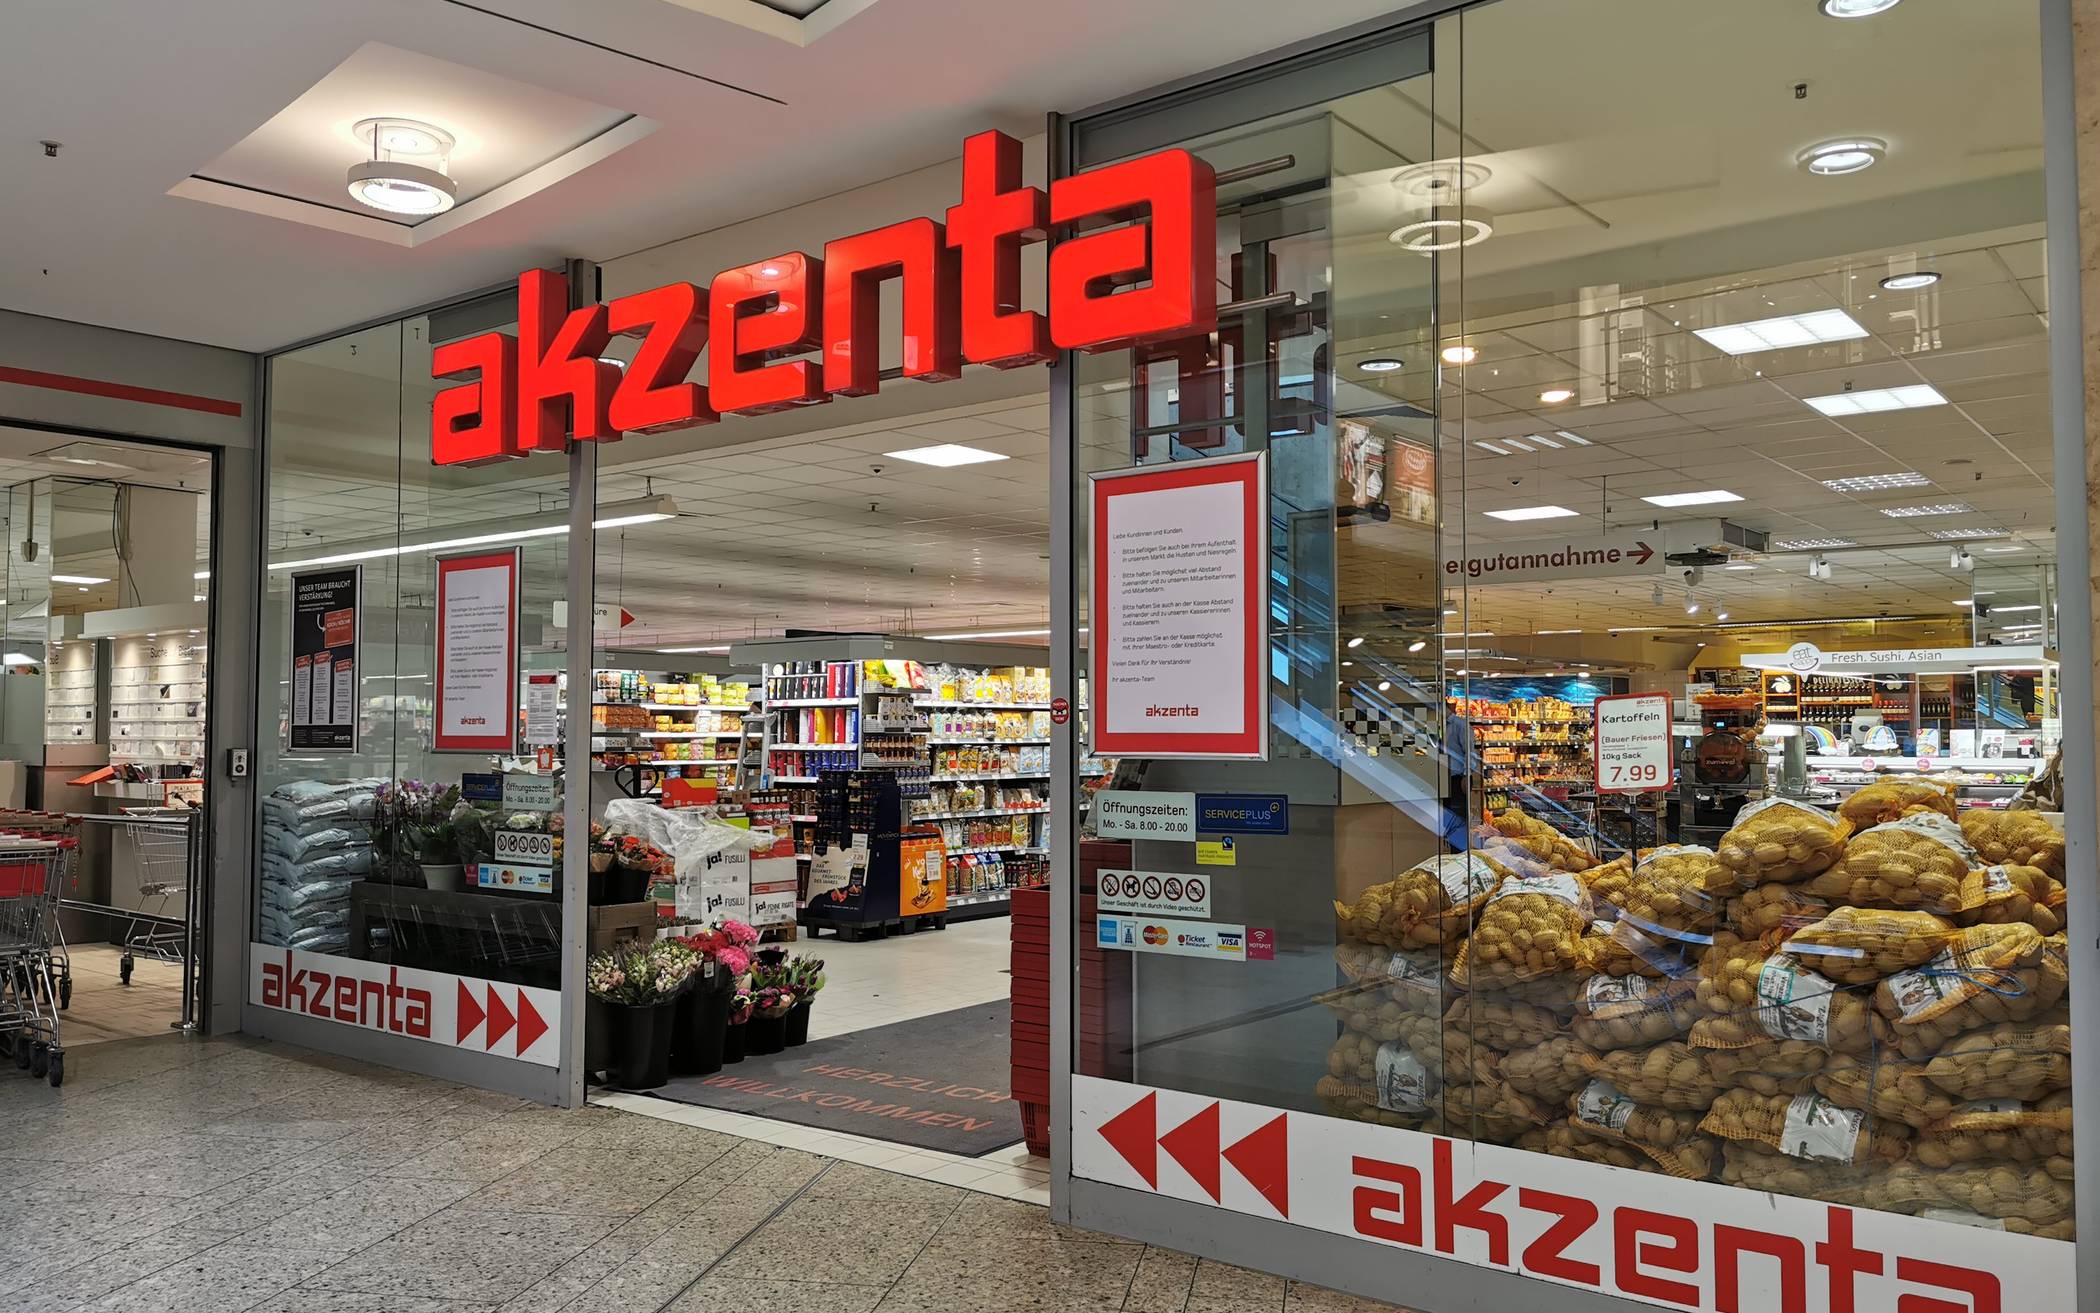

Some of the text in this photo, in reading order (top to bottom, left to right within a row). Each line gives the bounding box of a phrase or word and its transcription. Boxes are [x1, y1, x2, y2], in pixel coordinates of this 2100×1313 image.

[432, 128, 1216, 467] akzenta
[328, 580, 350, 589] BRAUCHT
[1832, 651, 1942, 663] Fresh. Sushi. Asian
[1145, 705, 1199, 717] akzenta
[460, 715, 485, 724] akzenta
[1602, 713, 1659, 723] Kartoffeln
[1632, 733, 1666, 741] Friesen)
[1610, 764, 1656, 782] 7.99
[506, 782, 550, 793] Öffnungszeiten:
[1103, 799, 1188, 817] Öffnungszeiten:
[1205, 809, 1271, 820] SERVICEPLUS
[1103, 821, 1117, 829] Mo.
[1125, 822, 1137, 830] Sa.
[1140, 822, 1157, 831] 8.00
[1165, 822, 1188, 832] 20.00
[706, 851, 745, 870] ja! FUSILLI
[707, 894, 745, 913] ja! FUSILLI
[755, 901, 766, 914] ja!
[1116, 900, 1139, 908] Geschäft
[1163, 903, 1177, 911] Video
[1185, 935, 1205, 943] Ticket
[1222, 938, 1239, 946] VISA
[262, 950, 431, 1038] akzenta
[802, 1063, 1011, 1104] HERZLICH
[702, 1074, 995, 1132] WILLKOMMEN
[1352, 1137, 2001, 1313] akzenta
